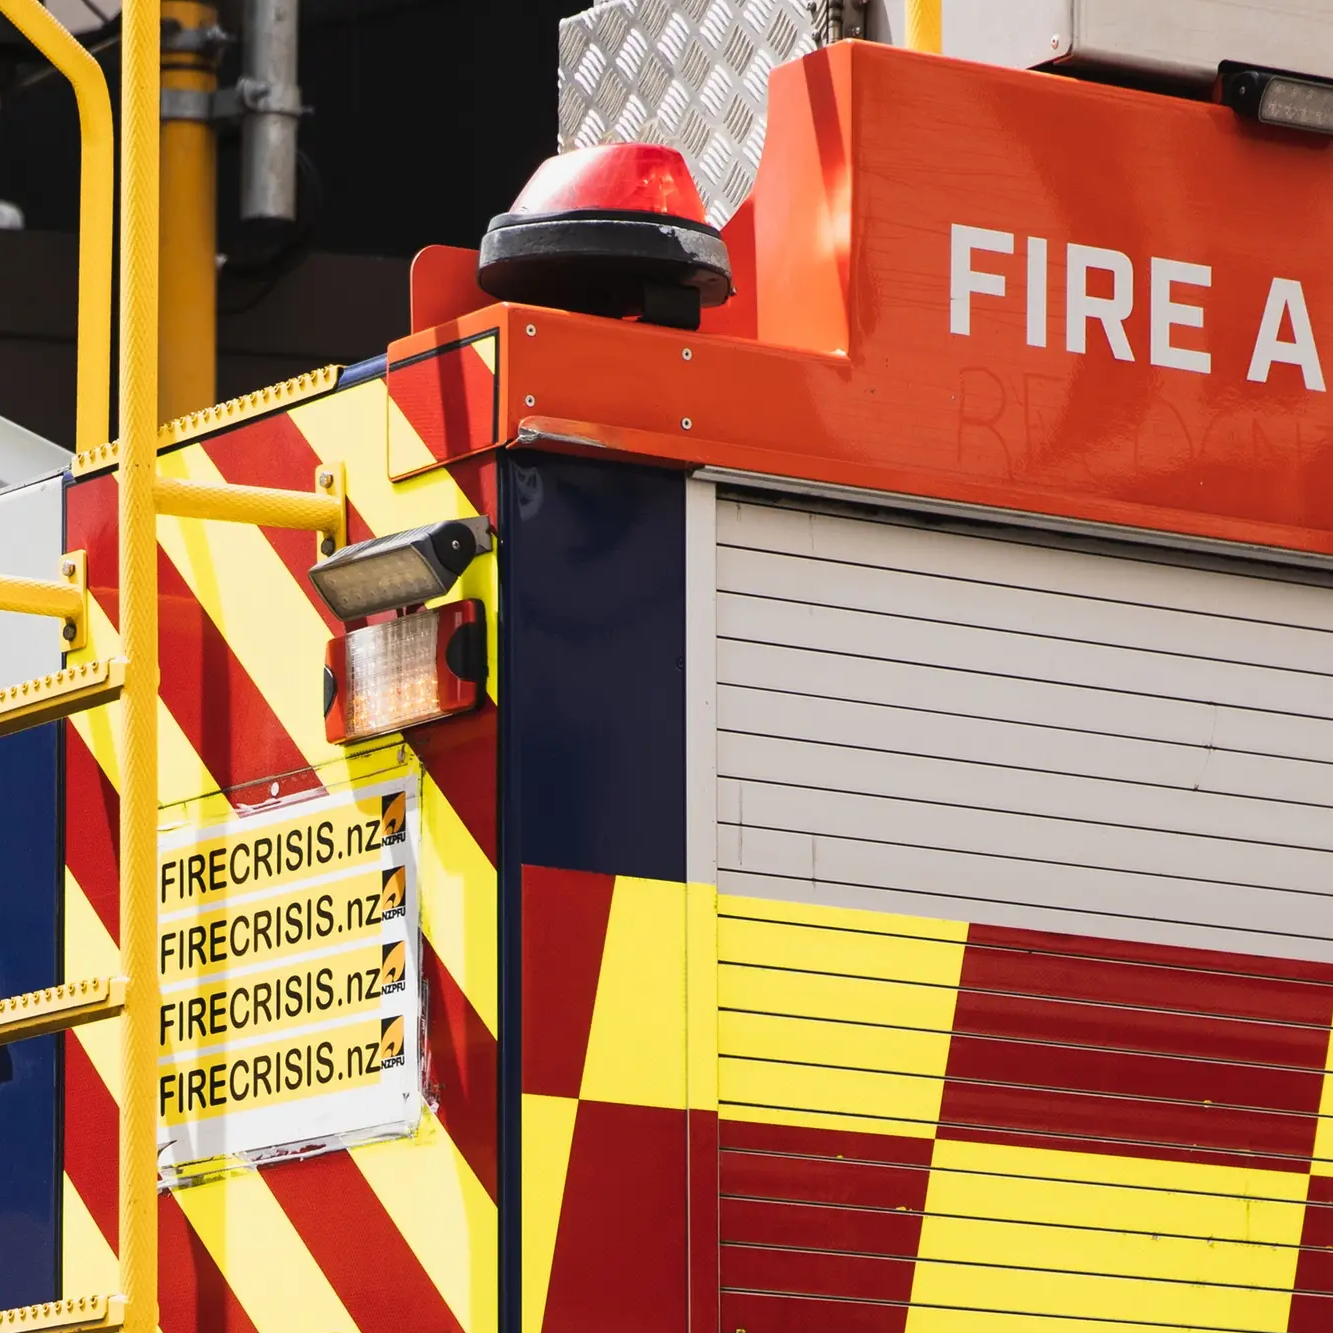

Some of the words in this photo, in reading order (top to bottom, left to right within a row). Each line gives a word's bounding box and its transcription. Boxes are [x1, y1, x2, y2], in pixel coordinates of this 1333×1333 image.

[950, 223, 1212, 374] FIRE
[1246, 277, 1327, 392] A
[161, 819, 382, 904] FIRECRISIS.nz
[160, 893, 382, 975] FIRECRISIS.nz
[160, 966, 381, 1046] FIRECRISIS.nz
[160, 1041, 381, 1118] FIRECRISIS.nz
